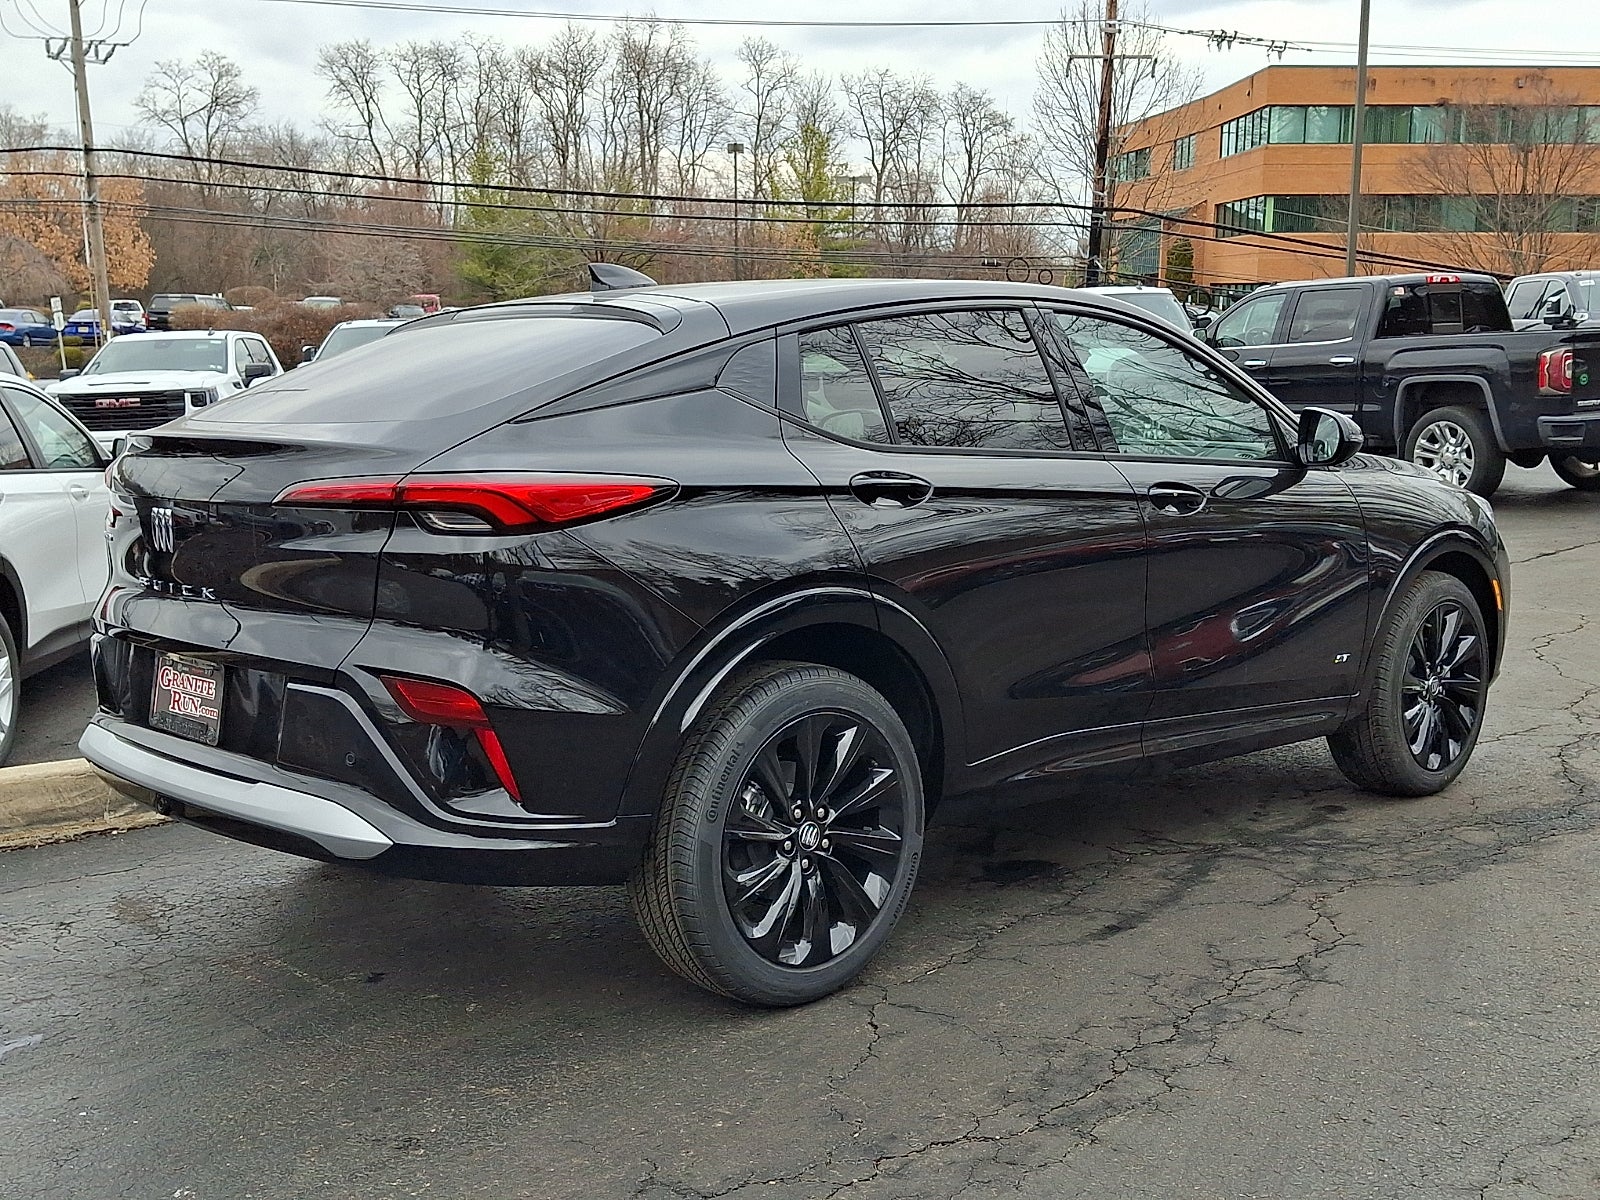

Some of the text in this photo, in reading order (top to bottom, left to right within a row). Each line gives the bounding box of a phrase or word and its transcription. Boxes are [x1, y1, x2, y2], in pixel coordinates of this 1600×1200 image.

[95, 397, 141, 408] GMC
[138, 577, 217, 600] BUICK
[160, 666, 215, 698] GRANITE
[706, 749, 740, 824] Continental
